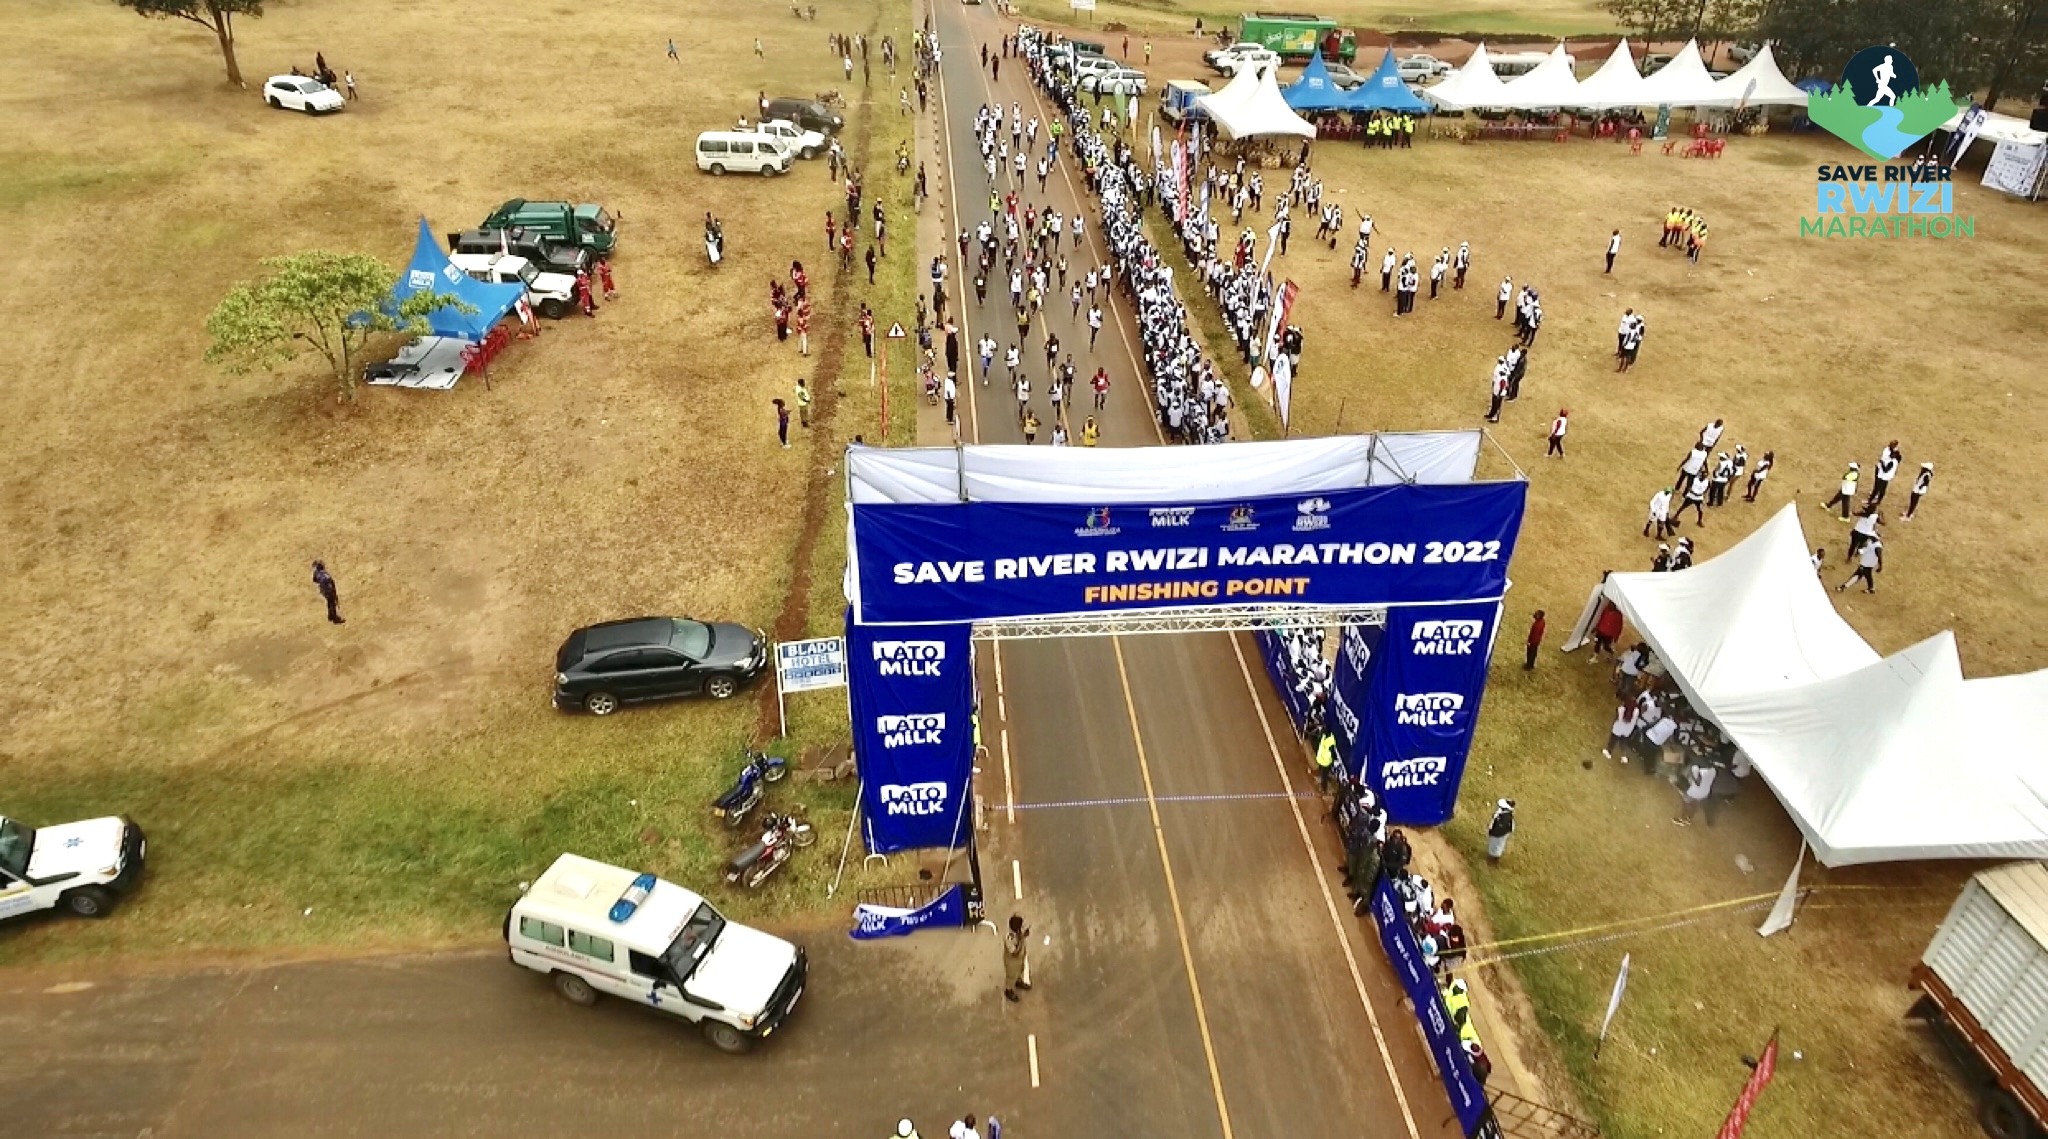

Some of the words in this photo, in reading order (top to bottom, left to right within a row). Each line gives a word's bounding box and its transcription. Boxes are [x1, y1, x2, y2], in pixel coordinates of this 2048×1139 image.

[892, 561, 985, 585] SAVE
[994, 552, 1096, 580] RIVER
[1106, 547, 1208, 573] RWIZI
[1217, 542, 1416, 567] MARATHON
[1423, 540, 1501, 564] 2022
[1084, 581, 1219, 604] FINISHING
[1226, 578, 1311, 596] POINT
[1419, 624, 1475, 639] LATO
[880, 645, 940, 660] LATO
[1402, 695, 1455, 710] LATO
[883, 716, 939, 731] LATO
[1389, 760, 1439, 774] LATO
[887, 787, 941, 801] LATO
